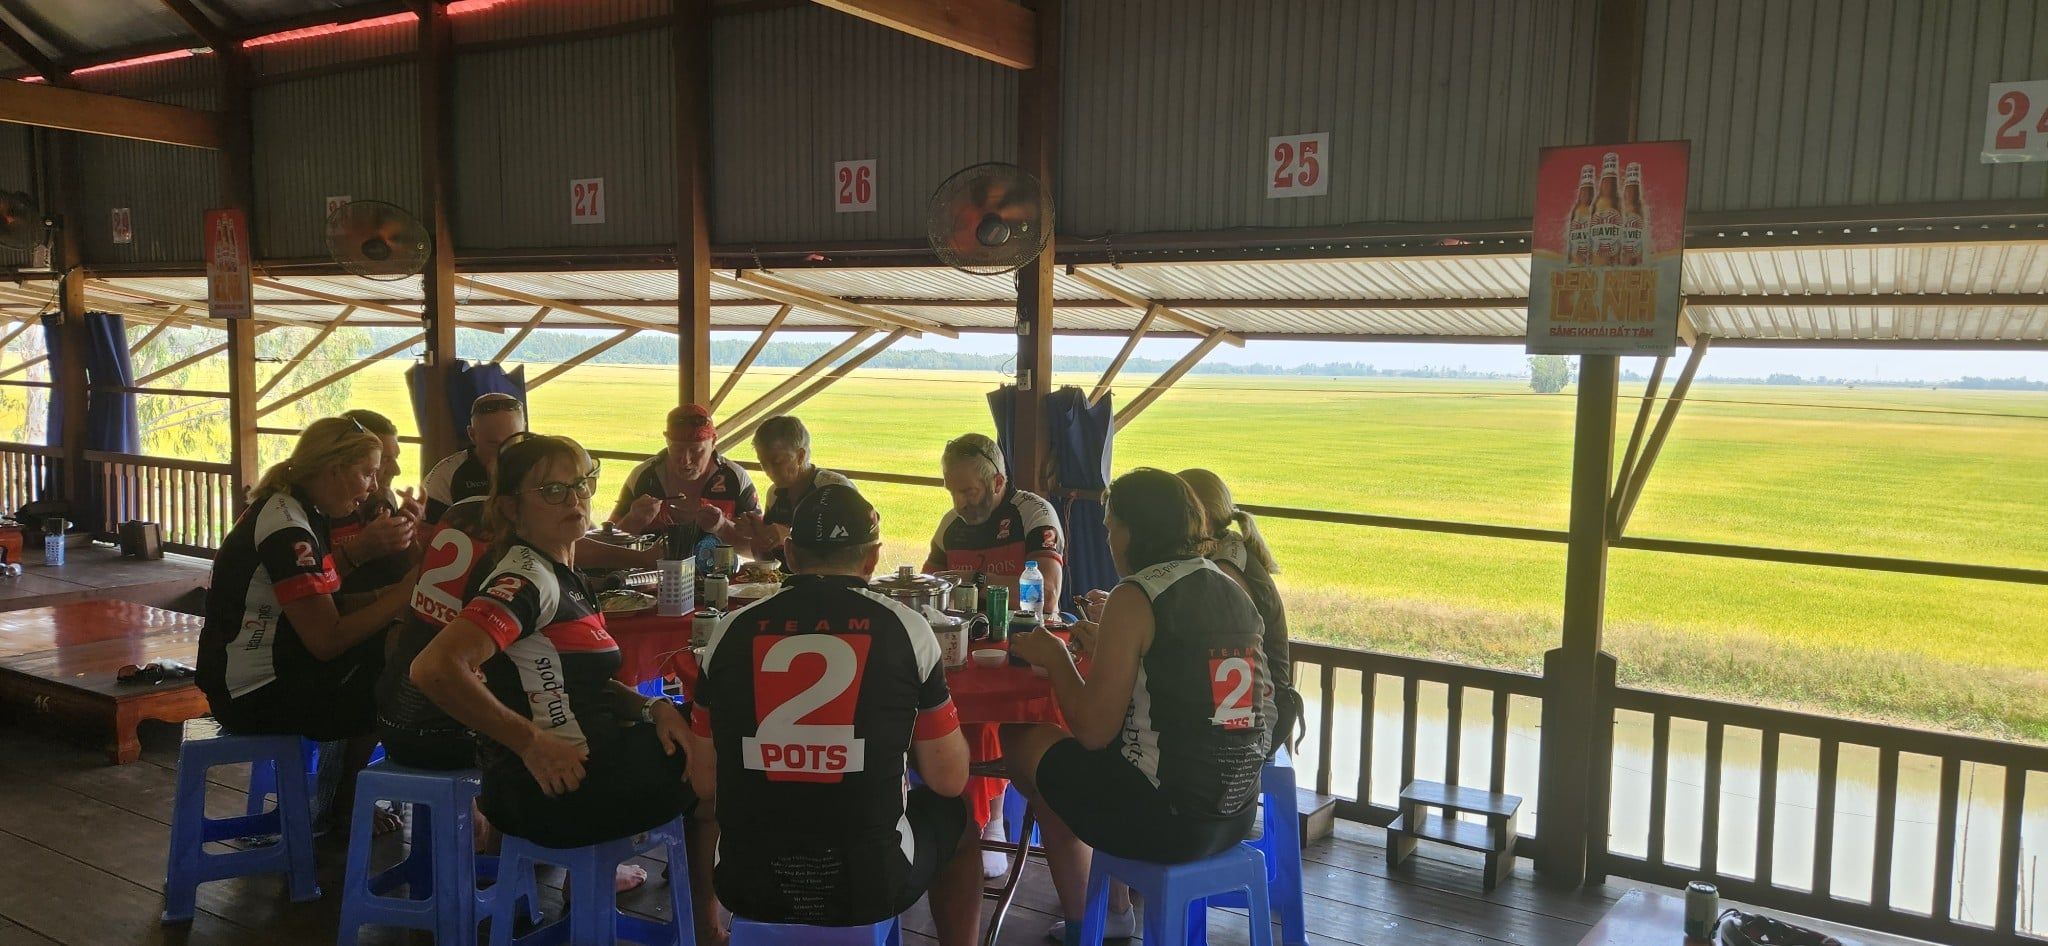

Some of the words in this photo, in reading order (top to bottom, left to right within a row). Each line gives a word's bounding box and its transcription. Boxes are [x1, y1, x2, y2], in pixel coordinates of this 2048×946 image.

[1273, 142, 1320, 188] 25
[573, 182, 600, 217] 27
[838, 165, 872, 206] 26
[295, 541, 314, 561] 2
[418, 528, 474, 606] 2
[493, 576, 522, 594] 2
[757, 618, 871, 631] TEAM
[1208, 646, 1257, 658] TEAM
[755, 634, 858, 739] 2
[1214, 657, 1253, 717] 2
[760, 743, 848, 771] POTS
